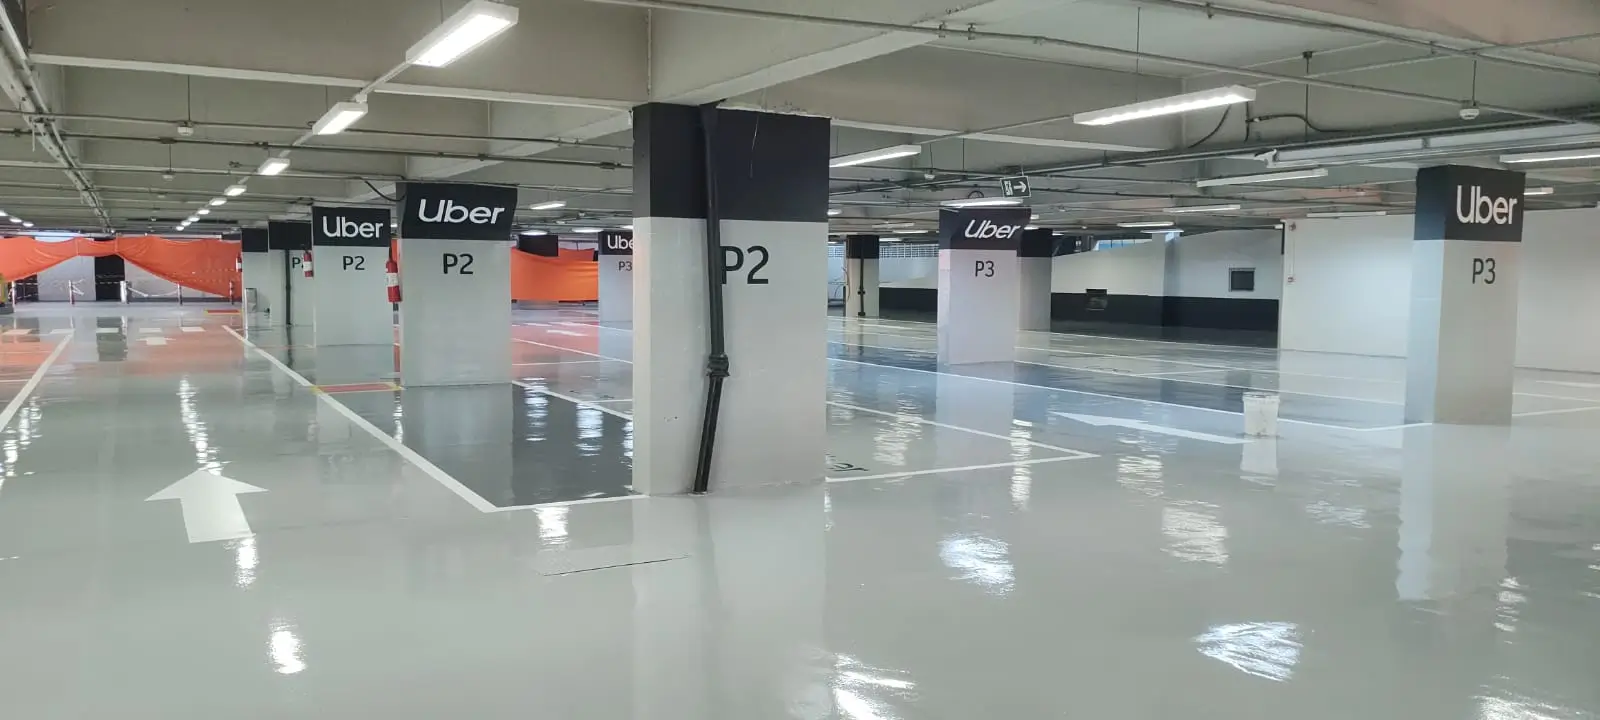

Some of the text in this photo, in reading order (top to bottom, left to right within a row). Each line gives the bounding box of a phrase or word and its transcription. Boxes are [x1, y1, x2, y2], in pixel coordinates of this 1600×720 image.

[418, 199, 505, 225] Uber
[1456, 185, 1518, 224] Uber
[322, 216, 384, 239] Uber
[964, 219, 1021, 240] Uber
[607, 234, 633, 250] Ube
[292, 257, 304, 269] P
[342, 255, 365, 271] P2
[442, 253, 474, 275] P2
[618, 260, 632, 272] P3
[719, 245, 769, 285] P2
[975, 260, 995, 278] P3
[1472, 258, 1496, 285] P3
